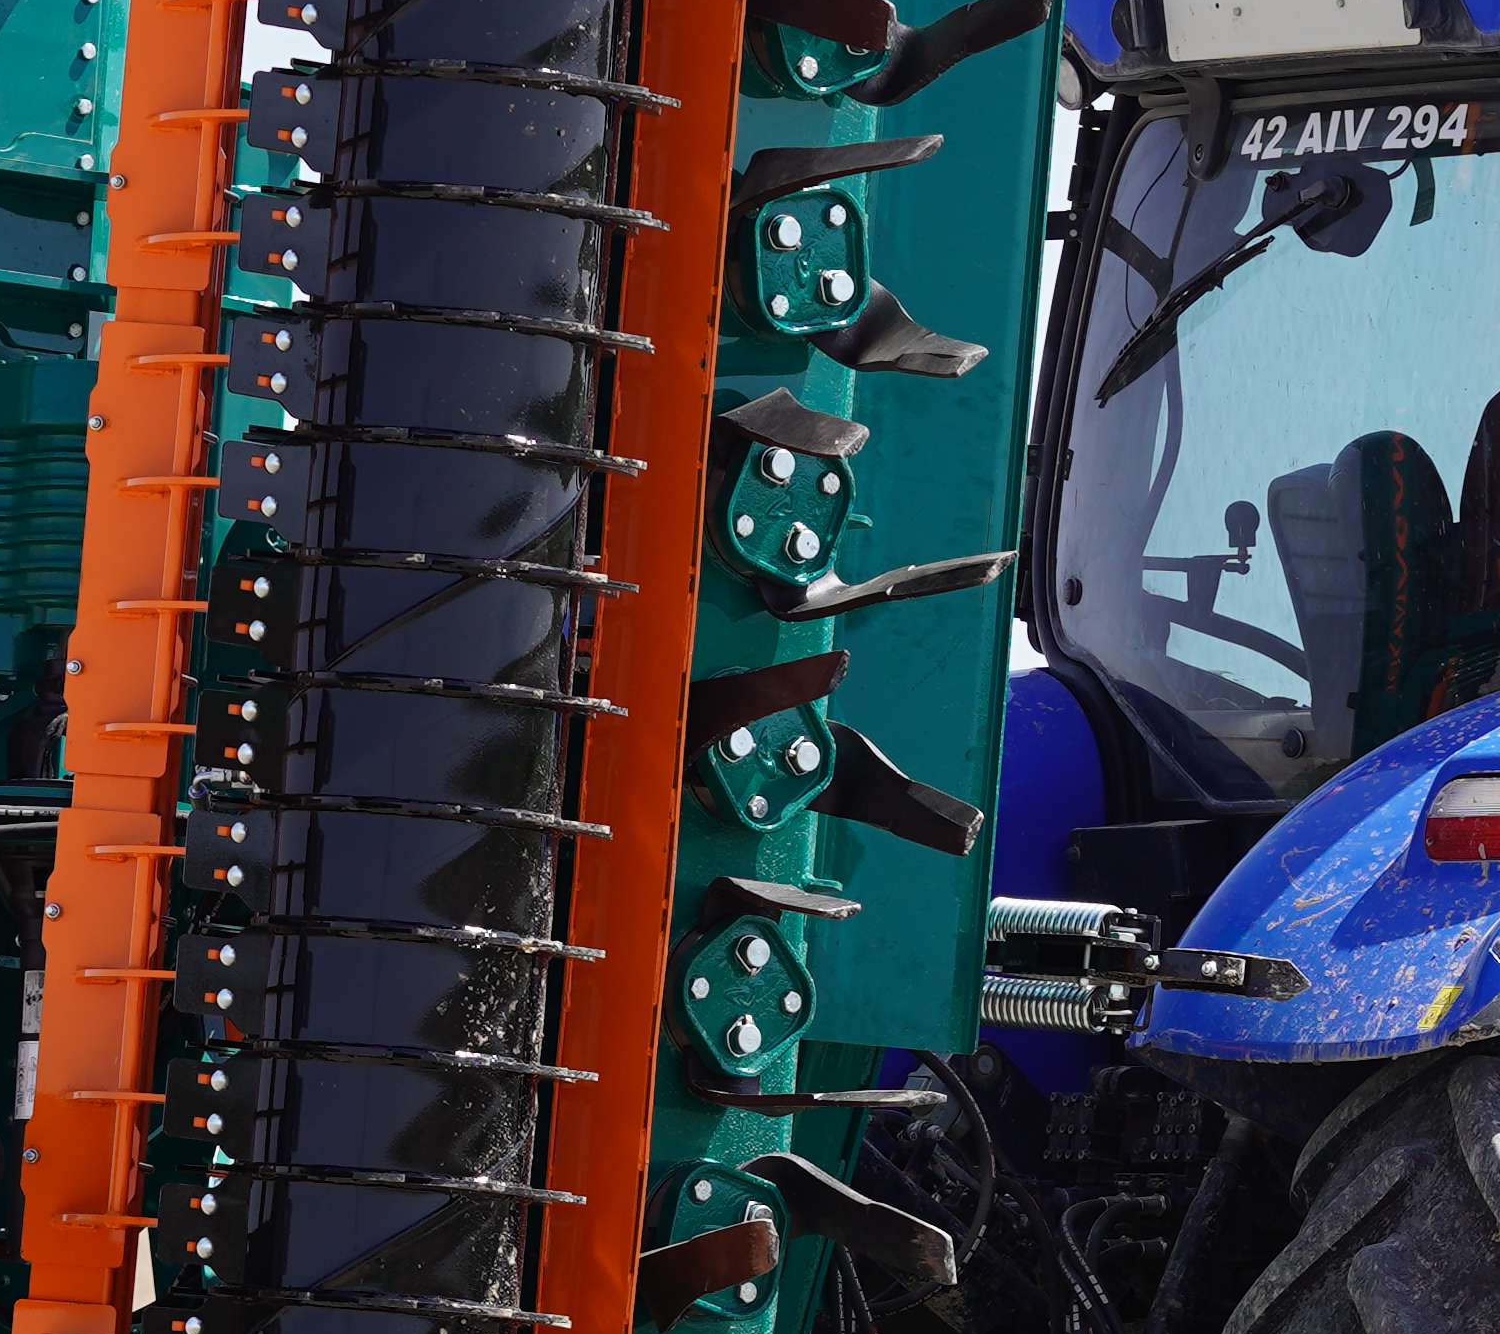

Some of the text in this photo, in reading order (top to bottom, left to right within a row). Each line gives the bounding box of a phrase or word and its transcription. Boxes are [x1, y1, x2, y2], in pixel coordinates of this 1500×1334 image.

[1241, 104, 1468, 161] 42 AIV 294
